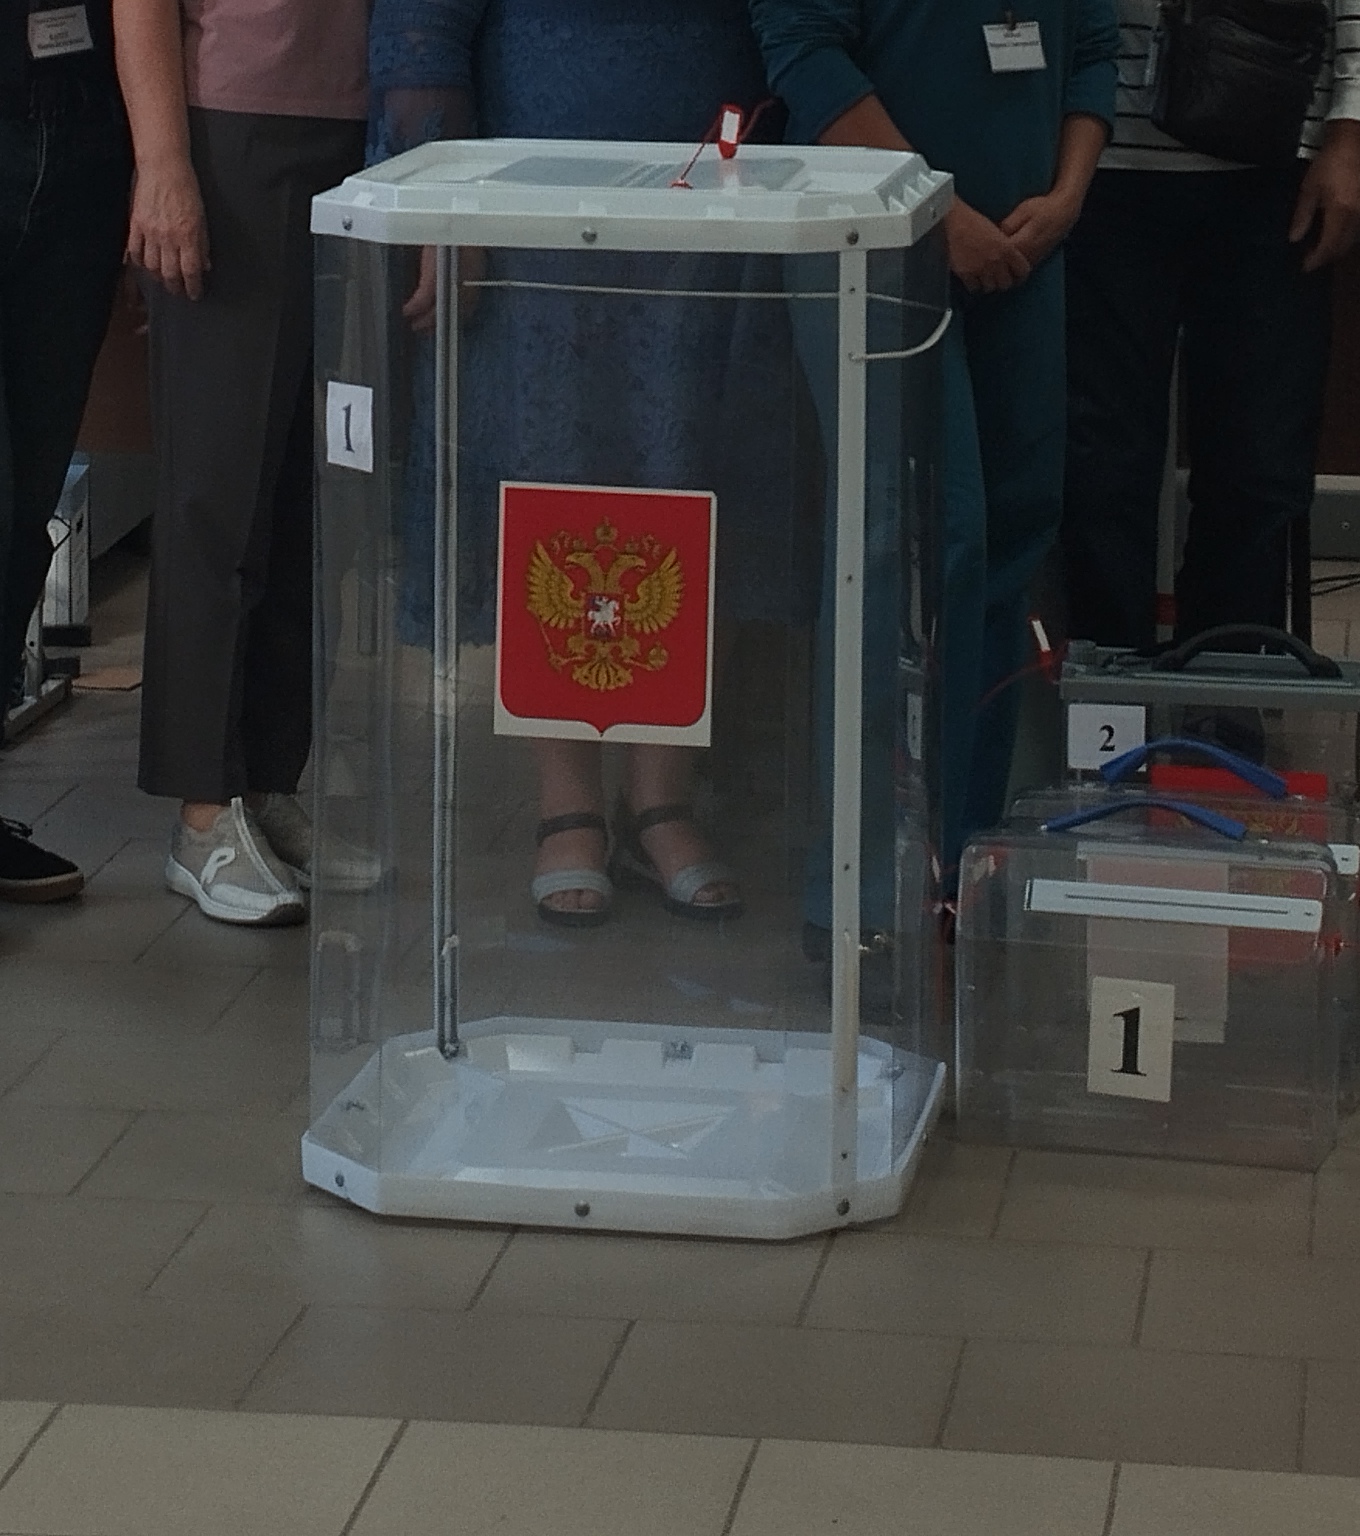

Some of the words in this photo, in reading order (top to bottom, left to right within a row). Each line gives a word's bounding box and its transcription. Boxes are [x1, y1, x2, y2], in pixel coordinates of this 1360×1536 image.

[342, 403, 355, 453] 1
[1099, 724, 1116, 753] 2
[1110, 1006, 1148, 1078] 1
